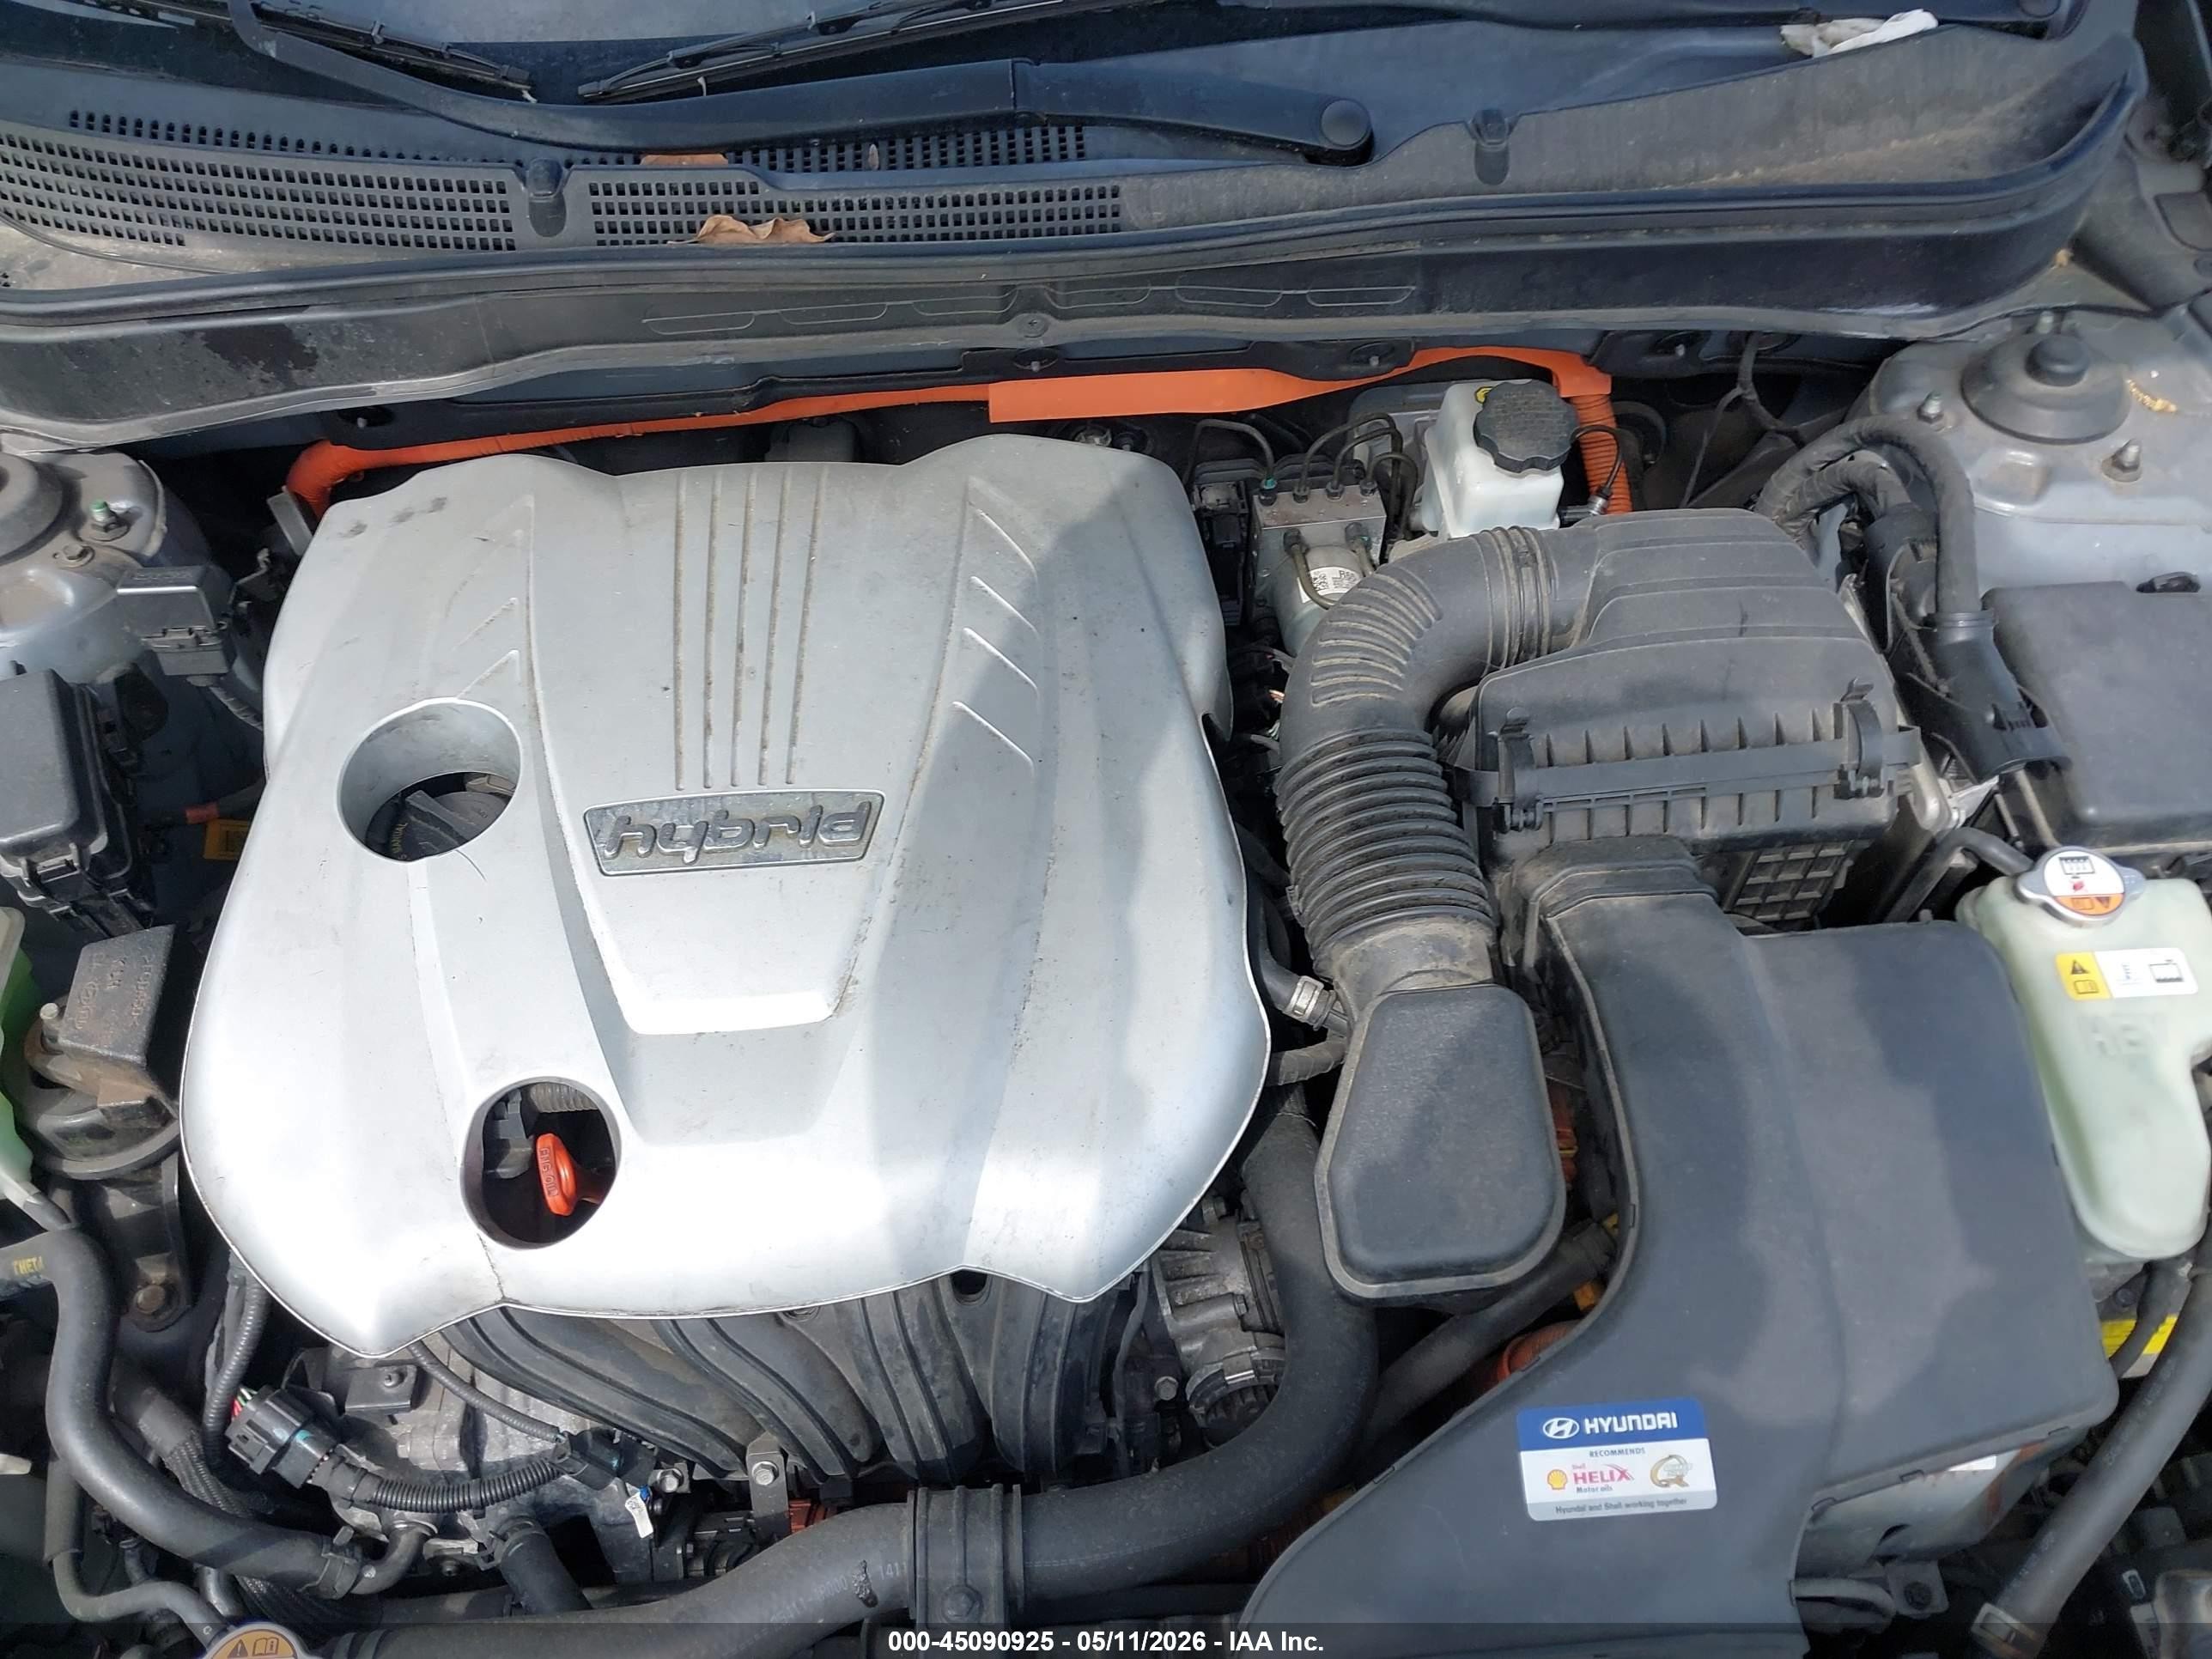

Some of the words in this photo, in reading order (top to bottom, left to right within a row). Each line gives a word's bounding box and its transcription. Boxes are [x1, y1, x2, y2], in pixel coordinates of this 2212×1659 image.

[604, 800, 872, 864] hybrid
[1584, 1412, 1679, 1435] HYUNDAI
[1589, 1447, 1646, 1458] RECOMMENDS
[1572, 1468, 1633, 1485] HELIX
[1576, 1486, 1598, 1494] Motor
[1555, 1504, 1586, 1514] Hyundai
[1589, 1503, 1602, 1511] and
[1604, 1502, 1622, 1511] Shell
[1625, 1500, 1655, 1510] working
[1656, 1498, 1687, 1507] together
